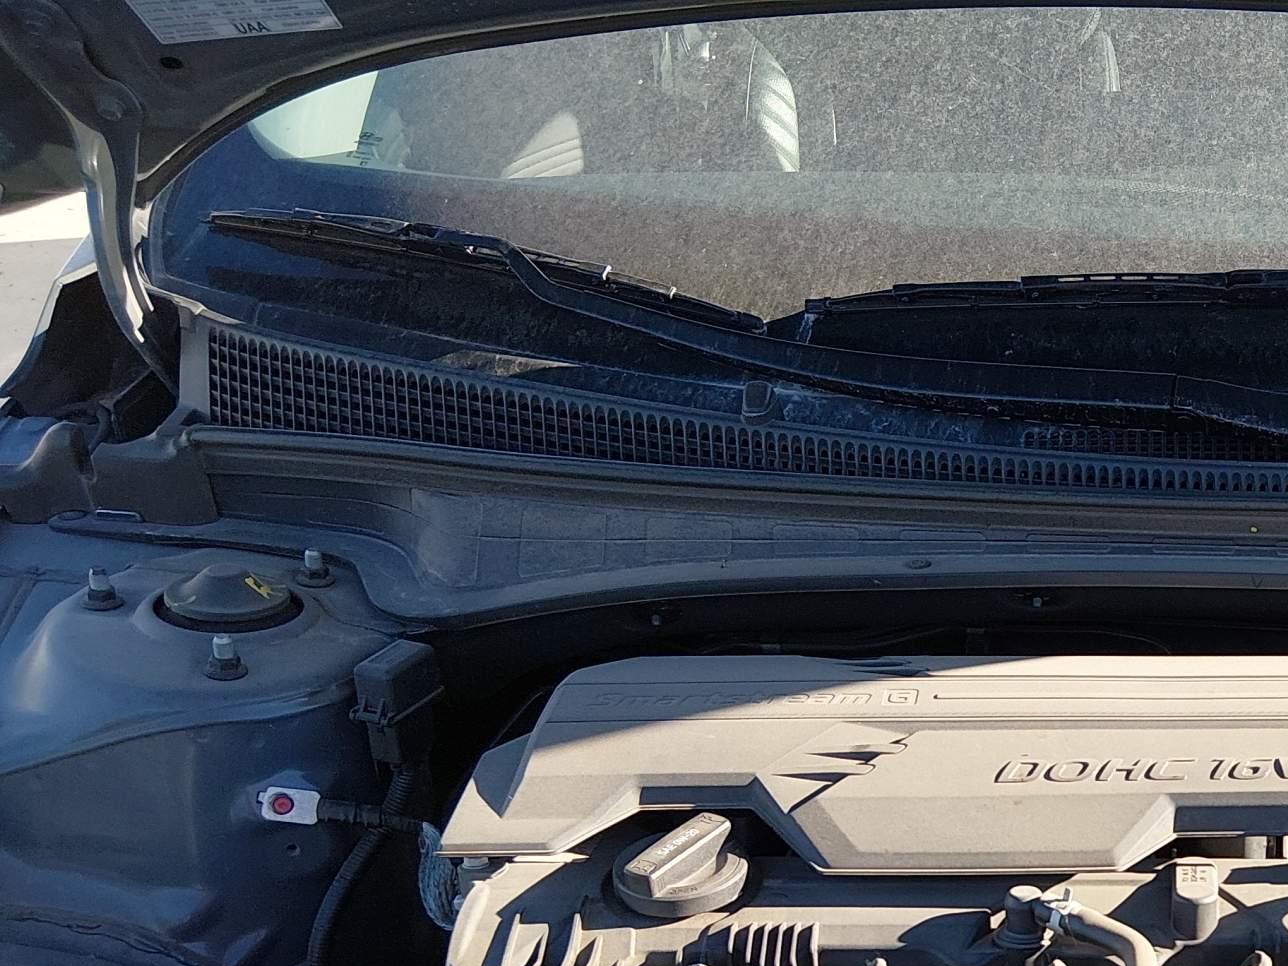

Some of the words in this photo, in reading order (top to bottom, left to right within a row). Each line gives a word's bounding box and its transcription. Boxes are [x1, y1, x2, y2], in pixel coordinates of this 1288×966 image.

[232, 21, 271, 35] UAA
[590, 690, 873, 707] Smartstream
[993, 757, 1199, 784] DOHC
